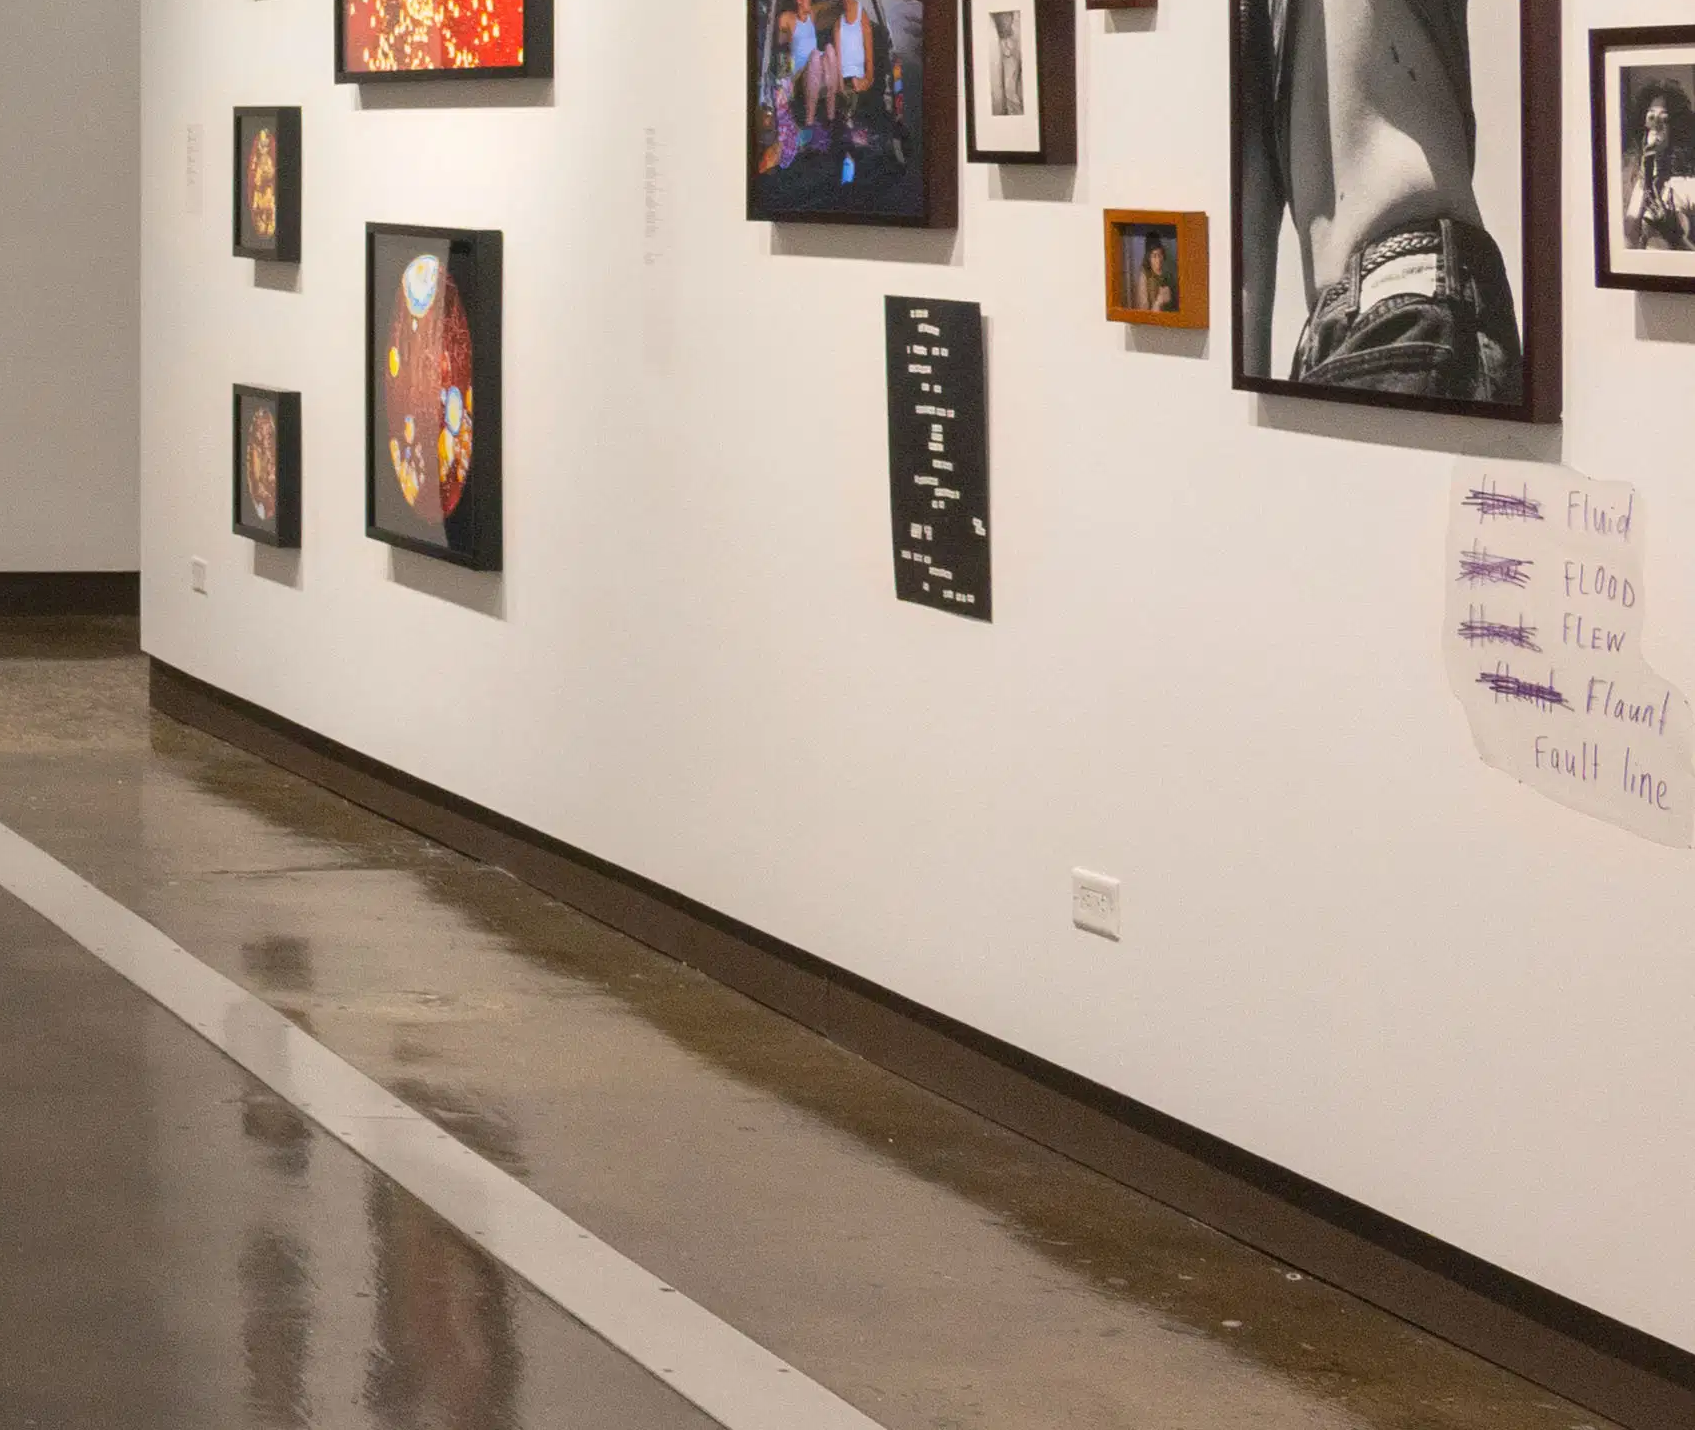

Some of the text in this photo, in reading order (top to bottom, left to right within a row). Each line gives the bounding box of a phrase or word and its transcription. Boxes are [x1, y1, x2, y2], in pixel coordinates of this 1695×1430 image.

[1567, 489, 1634, 541] Fluid
[1564, 560, 1635, 608] FLOOD
[1562, 612, 1626, 653] FLEW
[1586, 676, 1671, 735] Flaunt
[1534, 735, 1672, 811] Fault line
